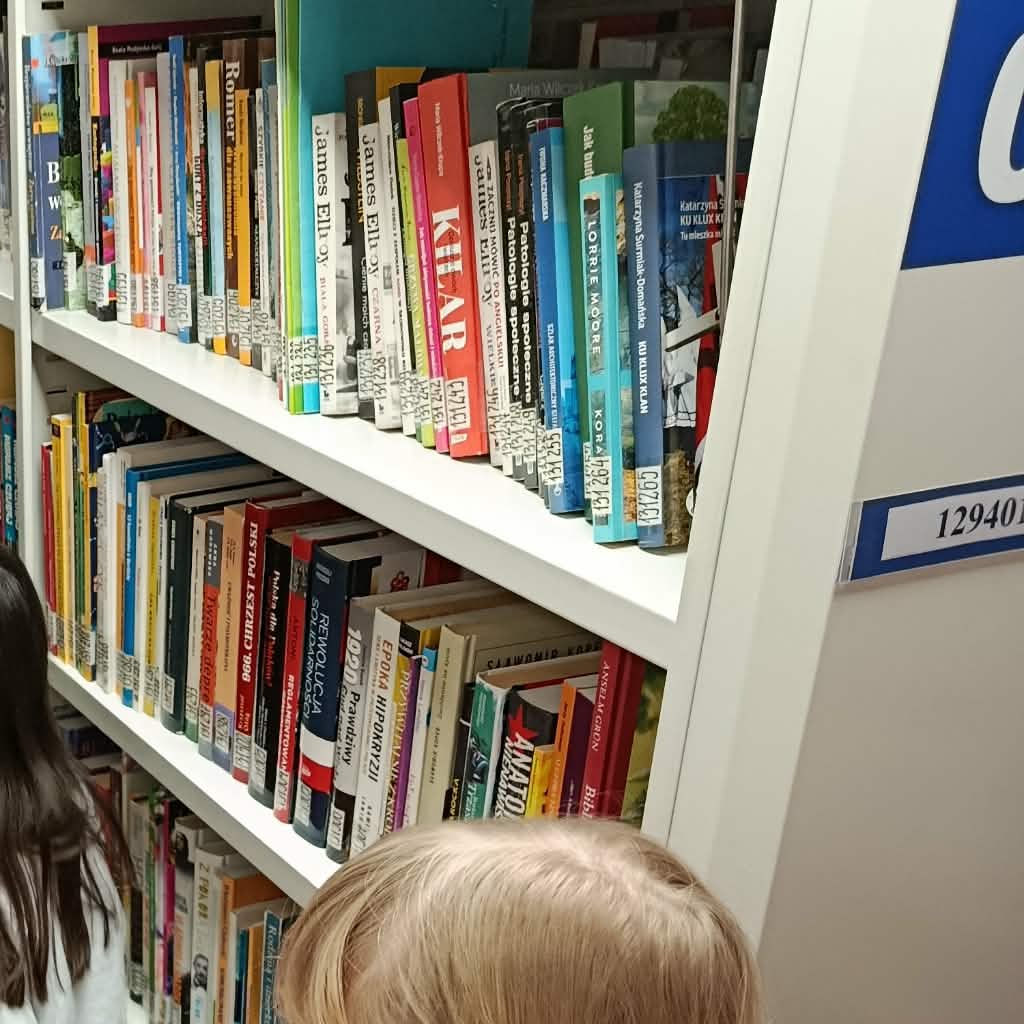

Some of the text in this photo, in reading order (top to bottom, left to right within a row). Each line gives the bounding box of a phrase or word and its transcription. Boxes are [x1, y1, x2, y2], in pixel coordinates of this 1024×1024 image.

[226, 60, 240, 143] Romer
[583, 125, 594, 148] Jak
[314, 125, 332, 268] James Ellroy
[362, 135, 380, 278] James Ellroy
[679, 200, 718, 213] Katarzyna
[680, 214, 691, 226] KU
[693, 213, 714, 226] KLUX
[432, 204, 468, 355] KILAR
[588, 221, 602, 355] LORRIE MOORE
[632, 182, 647, 330] Katarzyna Surmiak-Domańska
[507, 216, 520, 396] Patologie społeczne
[520, 221, 533, 404] Patologie społeczne
[318, 344, 334, 386] 131236
[373, 357, 387, 401] 131238
[430, 379, 444, 424] 131242
[447, 380, 466, 427] 131243
[638, 341, 649, 414] KU KLUX KLAN
[522, 408, 536, 459] 131249
[594, 410, 603, 454] KORA
[591, 458, 610, 511] 131264
[638, 471, 660, 524] 131265
[242, 521, 259, 682] 966. CHRZEST POLSKI
[201, 594, 217, 703] Twarze depre
[302, 597, 319, 720] SOLIDARNOŚCI
[311, 612, 330, 715] REWOLUCJA
[378, 639, 393, 691] EPOKA
[280, 674, 295, 771] REGLAMENTOWAN
[342, 626, 363, 766] 1920 Prawdziwy
[367, 695, 388, 782] HIPOKRYZJI
[590, 660, 610, 752] ANSELM GRÜN
[504, 731, 535, 818] ANATO
[581, 784, 597, 819] Bibl
